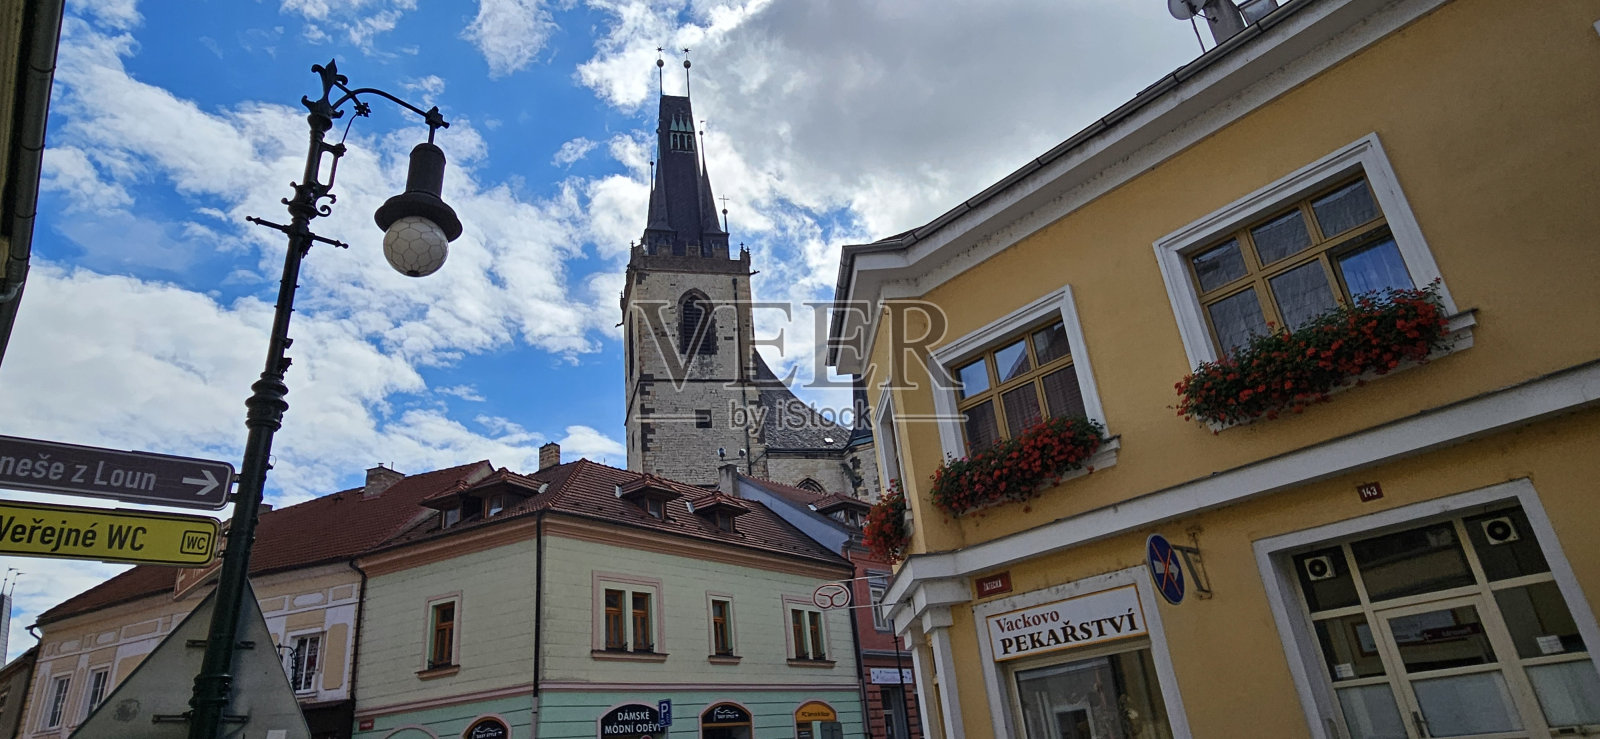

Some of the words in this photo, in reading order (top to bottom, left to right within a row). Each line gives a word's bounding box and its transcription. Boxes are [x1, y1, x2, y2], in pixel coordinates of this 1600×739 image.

[71, 464, 88, 483] z
[93, 460, 157, 491] Loun
[1361, 486, 1378, 498] 143
[0, 515, 98, 552] Veřejné
[107, 524, 147, 551] WC
[186, 535, 206, 550] WC
[995, 610, 1060, 633] Vackovo
[1000, 607, 1139, 655] PEKAŘSTVÍ
[617, 709, 650, 721] DÁMSKÉ
[604, 722, 634, 735] MÓDNÍ
